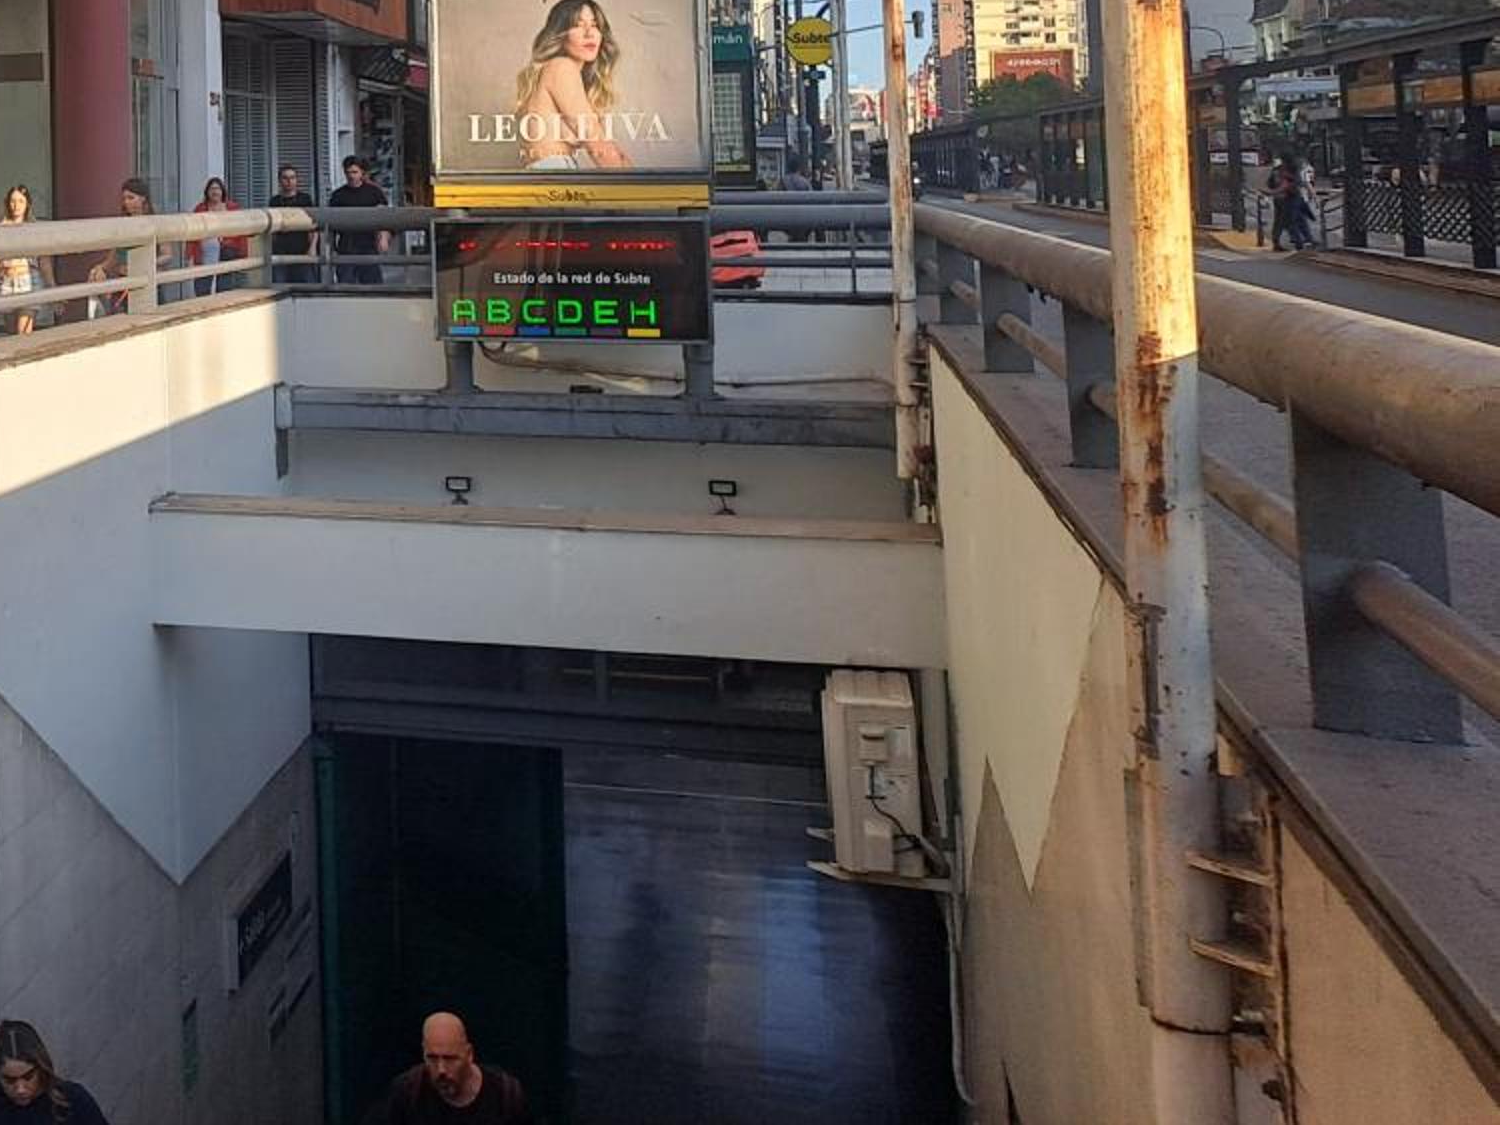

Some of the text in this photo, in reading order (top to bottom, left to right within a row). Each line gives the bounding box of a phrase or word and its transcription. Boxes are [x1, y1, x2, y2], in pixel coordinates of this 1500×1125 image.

[493, 272, 651, 284] Estado de la red de Subte
[452, 299, 656, 324] A B C D E H
